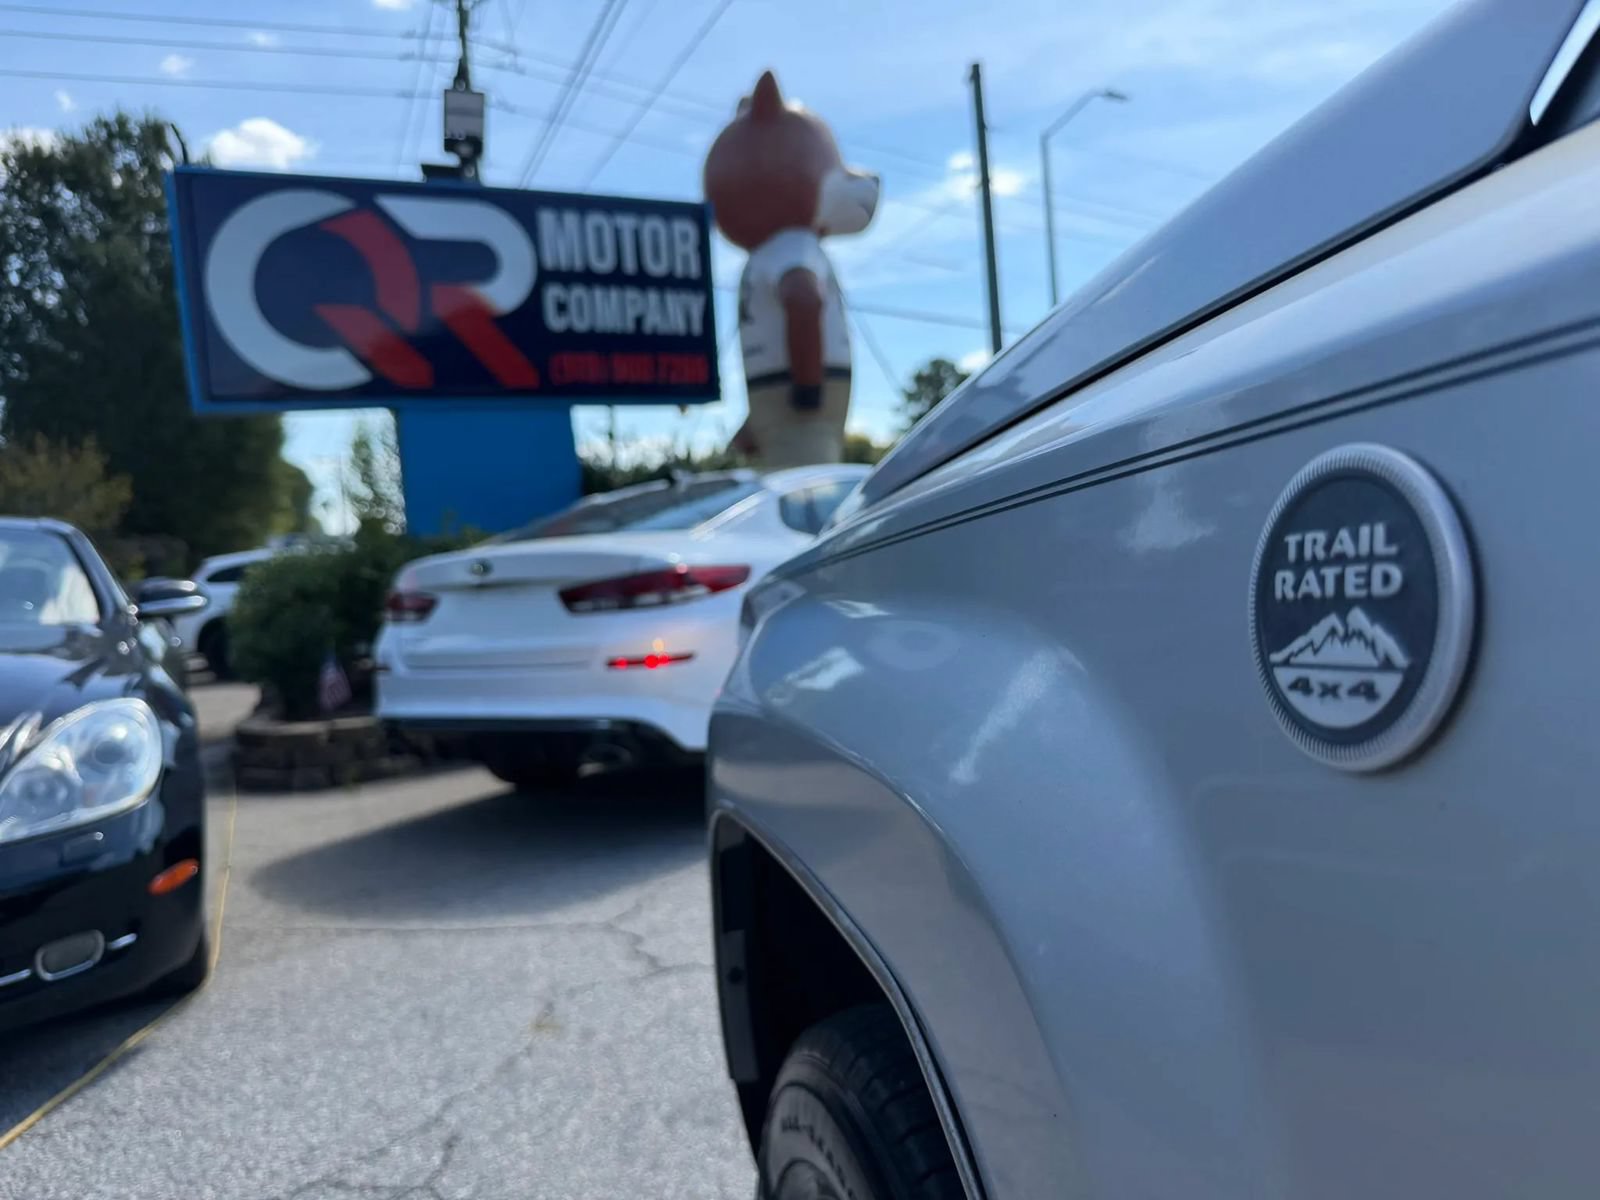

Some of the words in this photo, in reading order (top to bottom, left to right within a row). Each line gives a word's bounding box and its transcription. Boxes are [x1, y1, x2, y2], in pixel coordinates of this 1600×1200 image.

[537, 208, 701, 279] MOTOR
[542, 282, 705, 337] COMPANY
[1284, 522, 1398, 562] TRAIL
[1274, 563, 1403, 601] RATED
